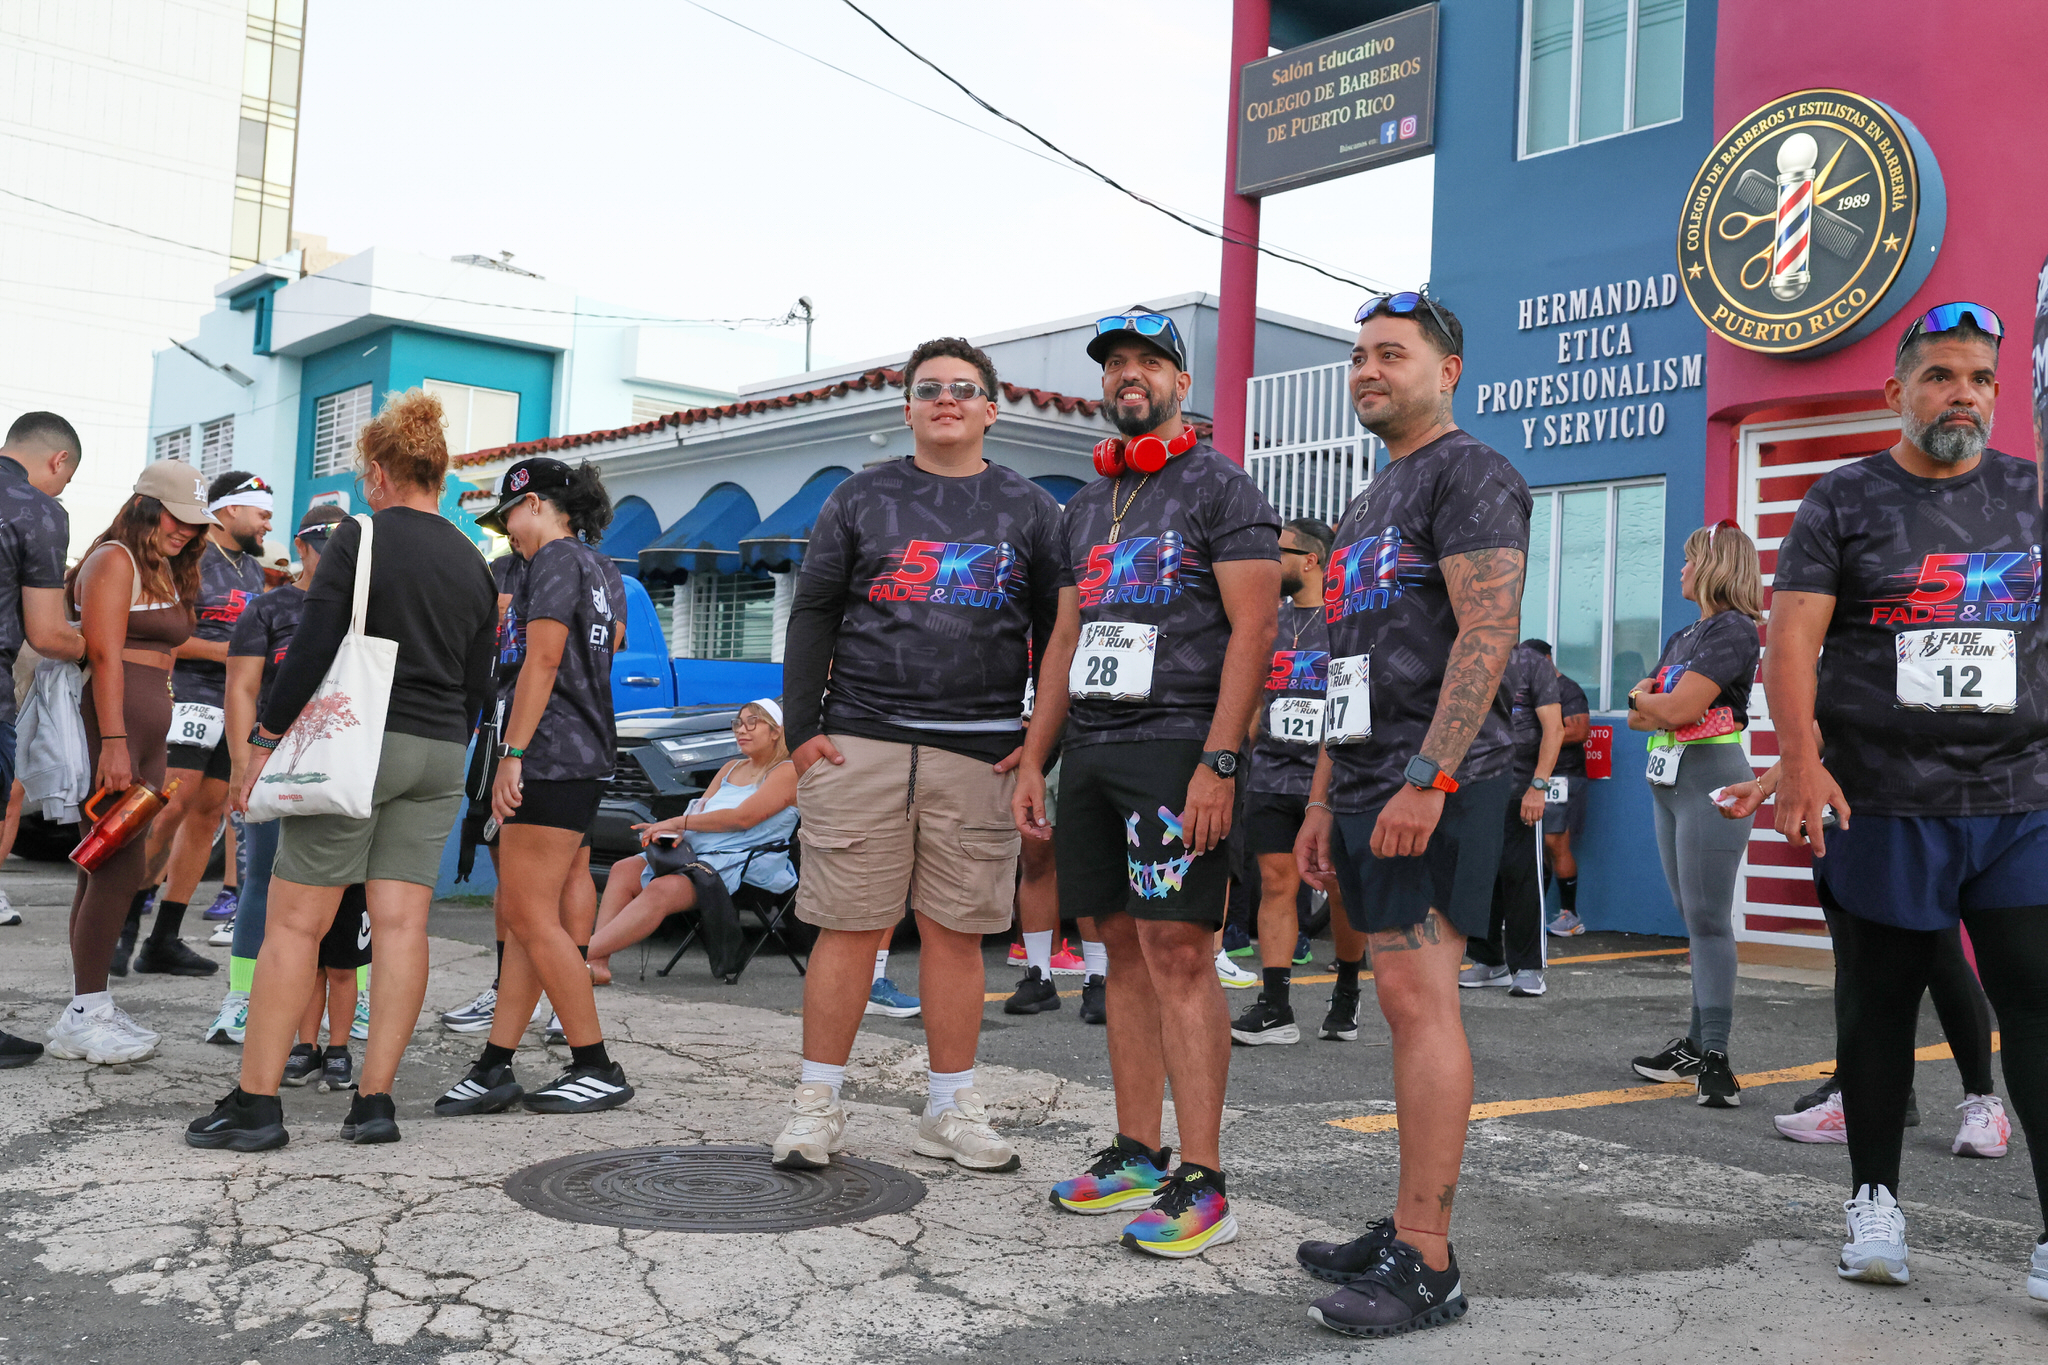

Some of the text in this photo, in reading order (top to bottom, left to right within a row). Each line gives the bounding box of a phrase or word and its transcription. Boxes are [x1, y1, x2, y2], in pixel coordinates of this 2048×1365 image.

[1272, 37, 1395, 86] Salón Educativo
[1247, 57, 1421, 122] COLEGIO DE BARBEROS
[1267, 94, 1395, 144] DE PUERTO RICO
[1686, 101, 1907, 251] COLEGIO DE BARBEROS Y ESTILISTAS EN BARBERÍA
[1836, 193, 1870, 211] 1989
[1518, 273, 1679, 330] HERMANDAD
[1711, 288, 1868, 342] PUERTO RICO
[1558, 322, 1633, 364] ETICA
[1476, 353, 1703, 415] PROFESIONALISM
[1522, 402, 1665, 449] Y SERVICIO
[892, 540, 996, 588] 5K
[1077, 536, 1157, 590] 5K
[1324, 536, 1379, 603] 5K
[1906, 552, 2029, 605] 5K
[868, 584, 931, 602] FADE
[930, 588, 949, 604] &
[1101, 588, 1115, 604] &
[1115, 585, 1171, 605] RUN
[1349, 589, 1390, 615] RUN
[1870, 604, 1958, 625] FADE
[1959, 604, 1981, 622] &
[1095, 625, 1124, 637] FADE
[1105, 637, 1134, 649] RUN
[1939, 632, 1983, 645] FADE
[1270, 651, 1328, 678] 5K
[1950, 645, 1996, 657] & RUN
[1085, 656, 1119, 686] 28
[1288, 679, 1299, 690] &
[1937, 665, 1983, 697] 12
[1291, 699, 1312, 708] FADE
[182, 721, 207, 740] 88
[1282, 717, 1314, 737] 121
